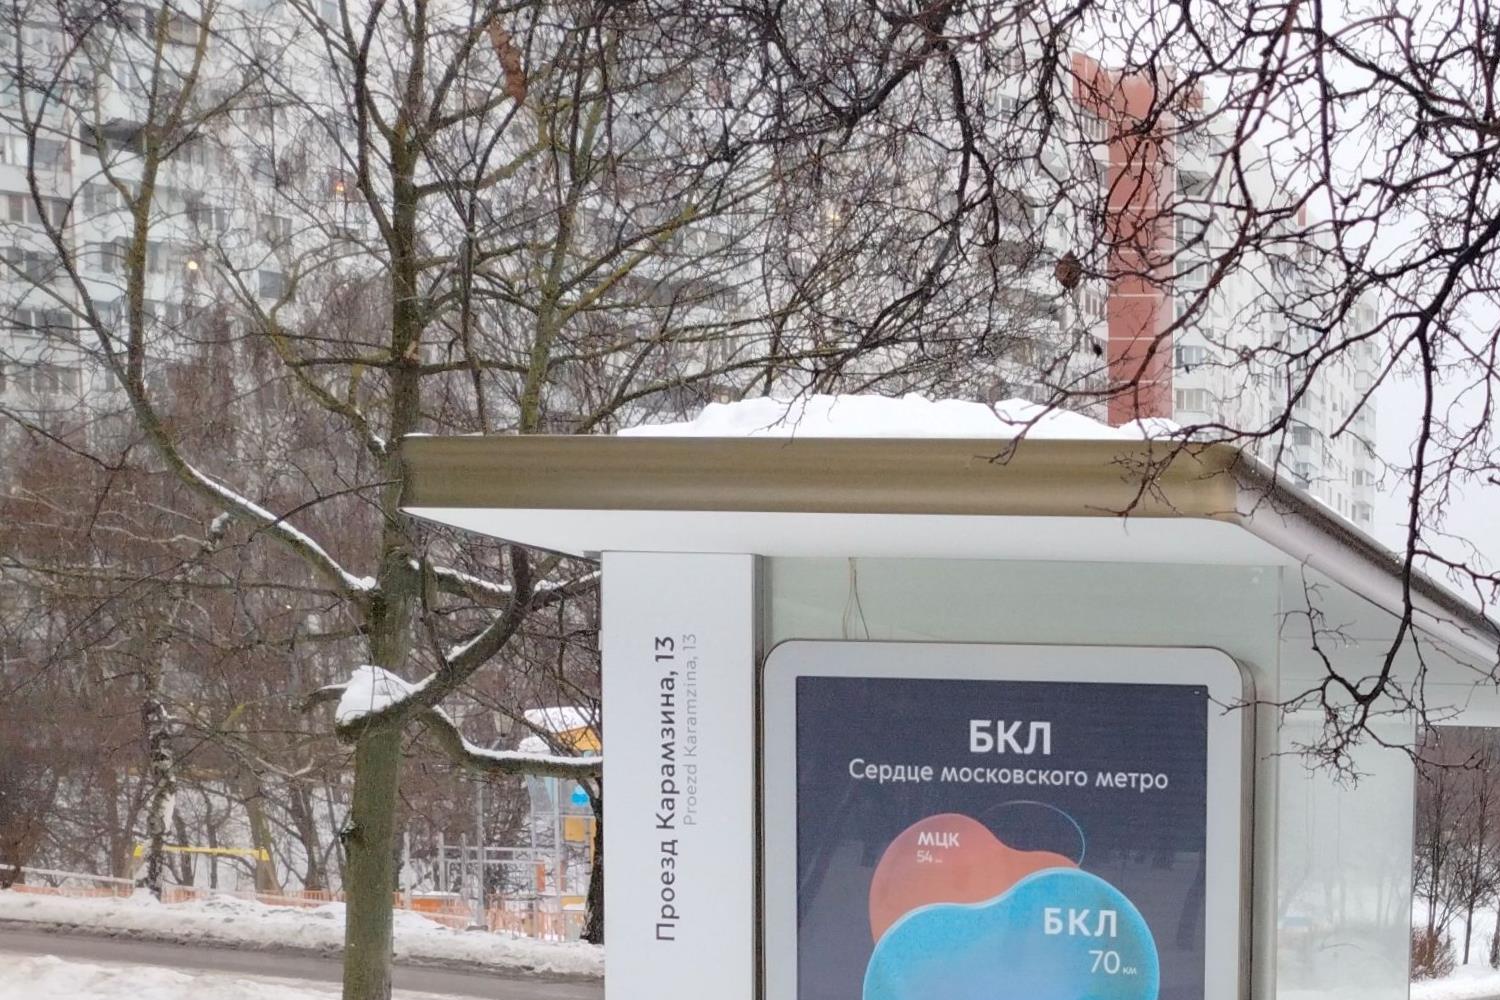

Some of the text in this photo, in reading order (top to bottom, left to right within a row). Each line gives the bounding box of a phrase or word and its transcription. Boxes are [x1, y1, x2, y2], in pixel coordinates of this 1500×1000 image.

[682, 633, 699, 826] Proezd Karamzina, 13
[969, 719, 1051, 755] БКЛ
[655, 636, 680, 942] Проезд Карамзина, 13
[849, 757, 1169, 793] Сердце московского метро
[917, 831, 960, 849] МЦК
[916, 850, 933, 864] 54
[1044, 907, 1117, 938] БКЛ
[1088, 950, 1137, 975] 70 км
